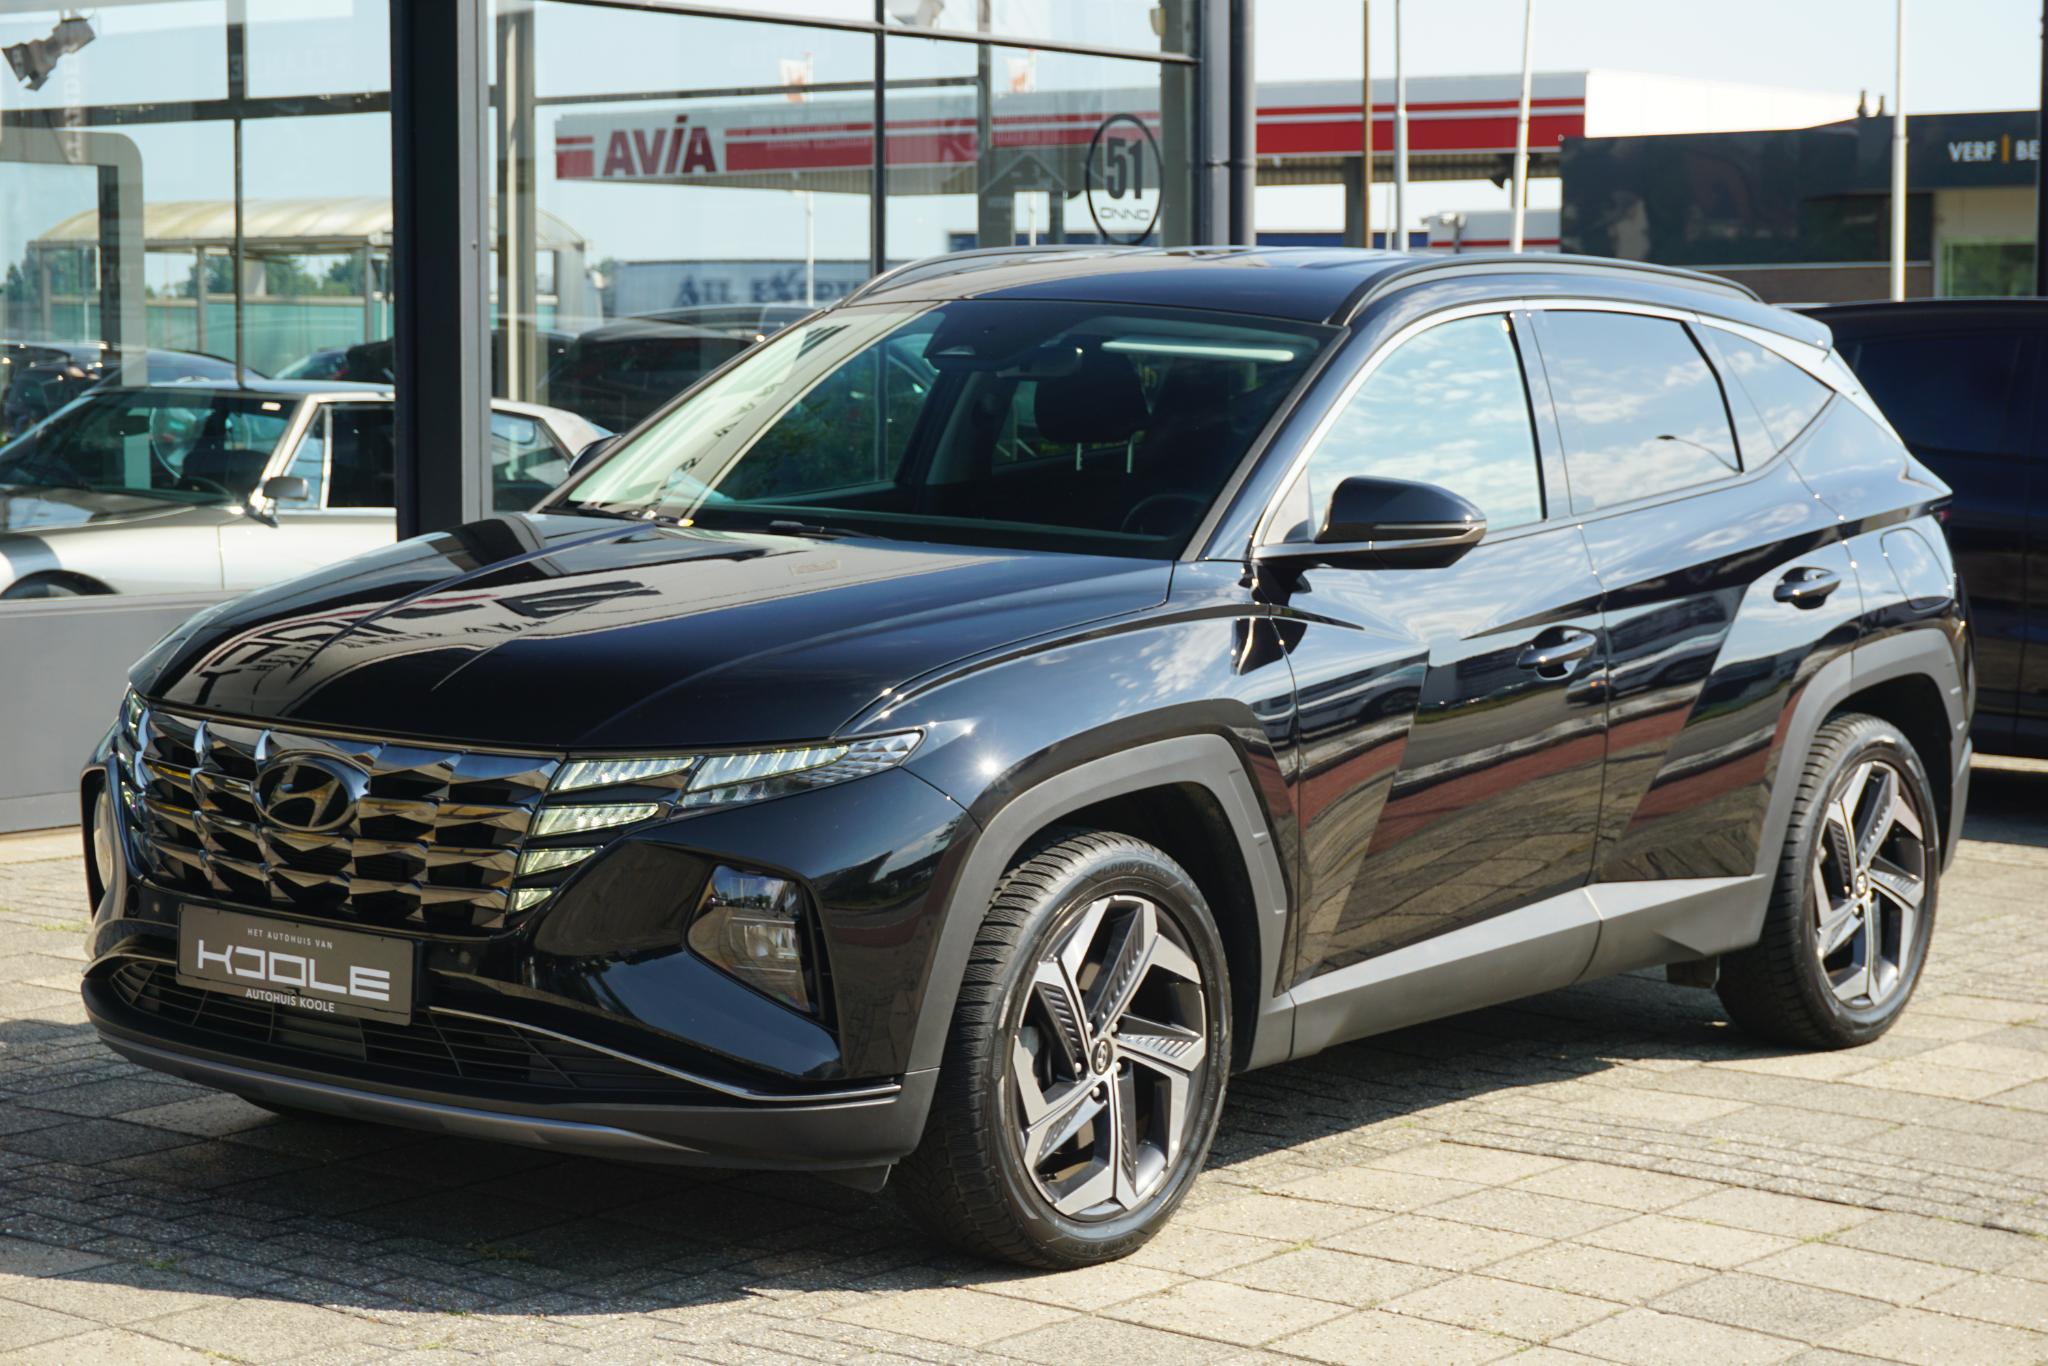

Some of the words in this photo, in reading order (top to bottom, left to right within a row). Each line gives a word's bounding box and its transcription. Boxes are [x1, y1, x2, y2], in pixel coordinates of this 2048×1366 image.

[1948, 140, 1997, 162] VERF
[1107, 138, 1142, 199] 51
[247, 927, 264, 938] HET
[267, 931, 312, 947] AUTOHUIS
[315, 938, 334, 950] VAN
[197, 939, 390, 1002] KOOLE
[245, 988, 298, 1007] AUTOHUIS
[299, 996, 336, 1013] KOOLE
